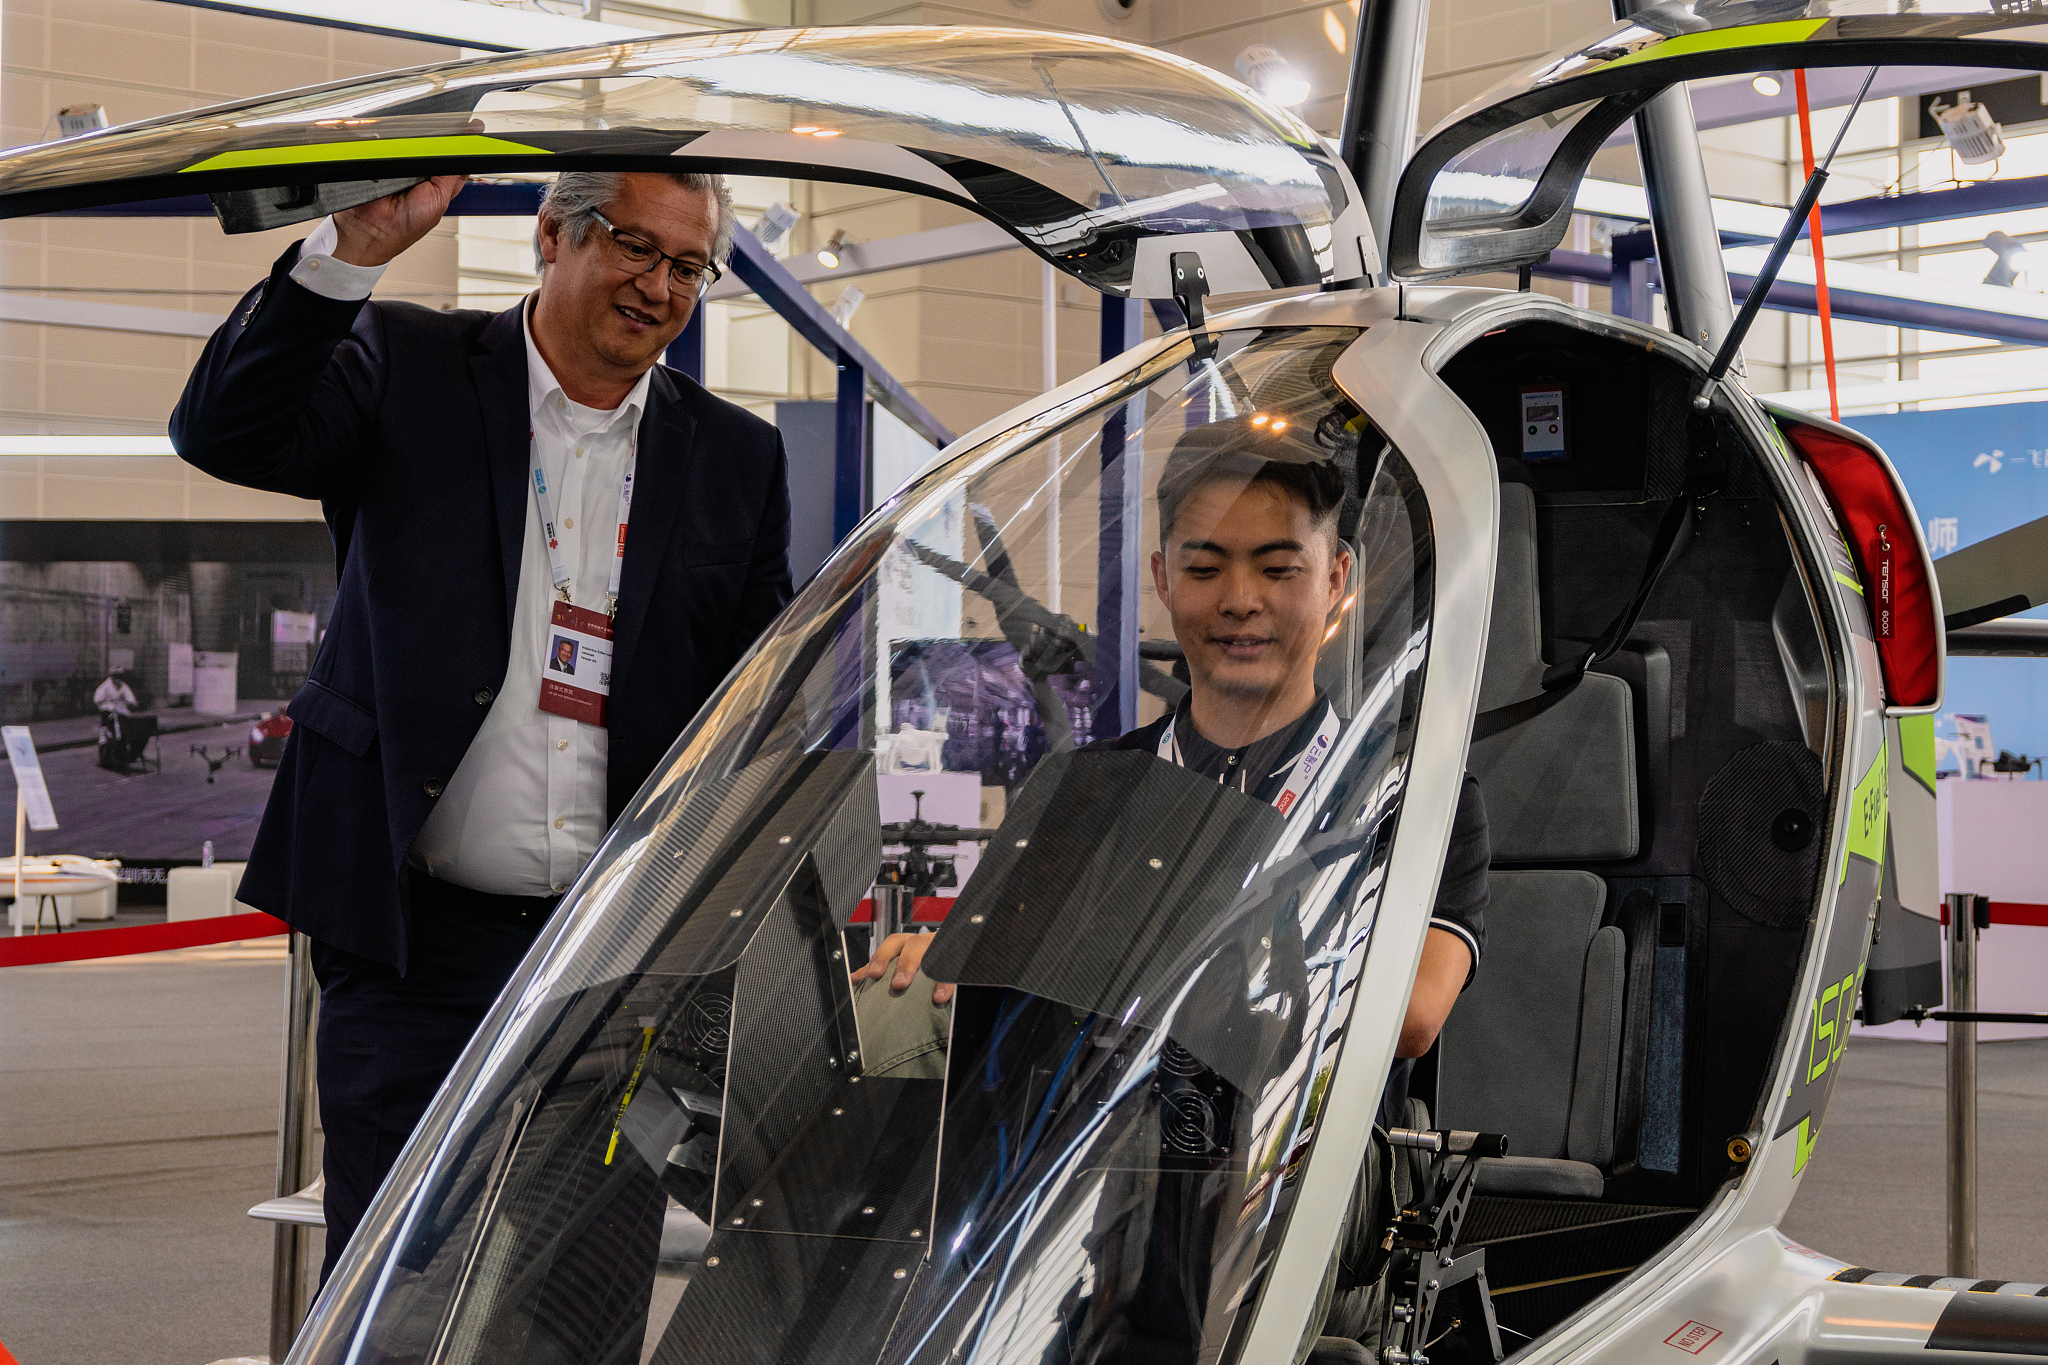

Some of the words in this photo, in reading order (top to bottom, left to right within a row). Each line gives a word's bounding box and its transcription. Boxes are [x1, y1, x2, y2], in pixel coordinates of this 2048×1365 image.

[1928, 517, 1959, 553] 师
[1881, 609, 1889, 636] 600X
[1278, 793, 1293, 812] Leno
[1677, 1337, 1695, 1348] NO
[1686, 1326, 1708, 1341] STEP
